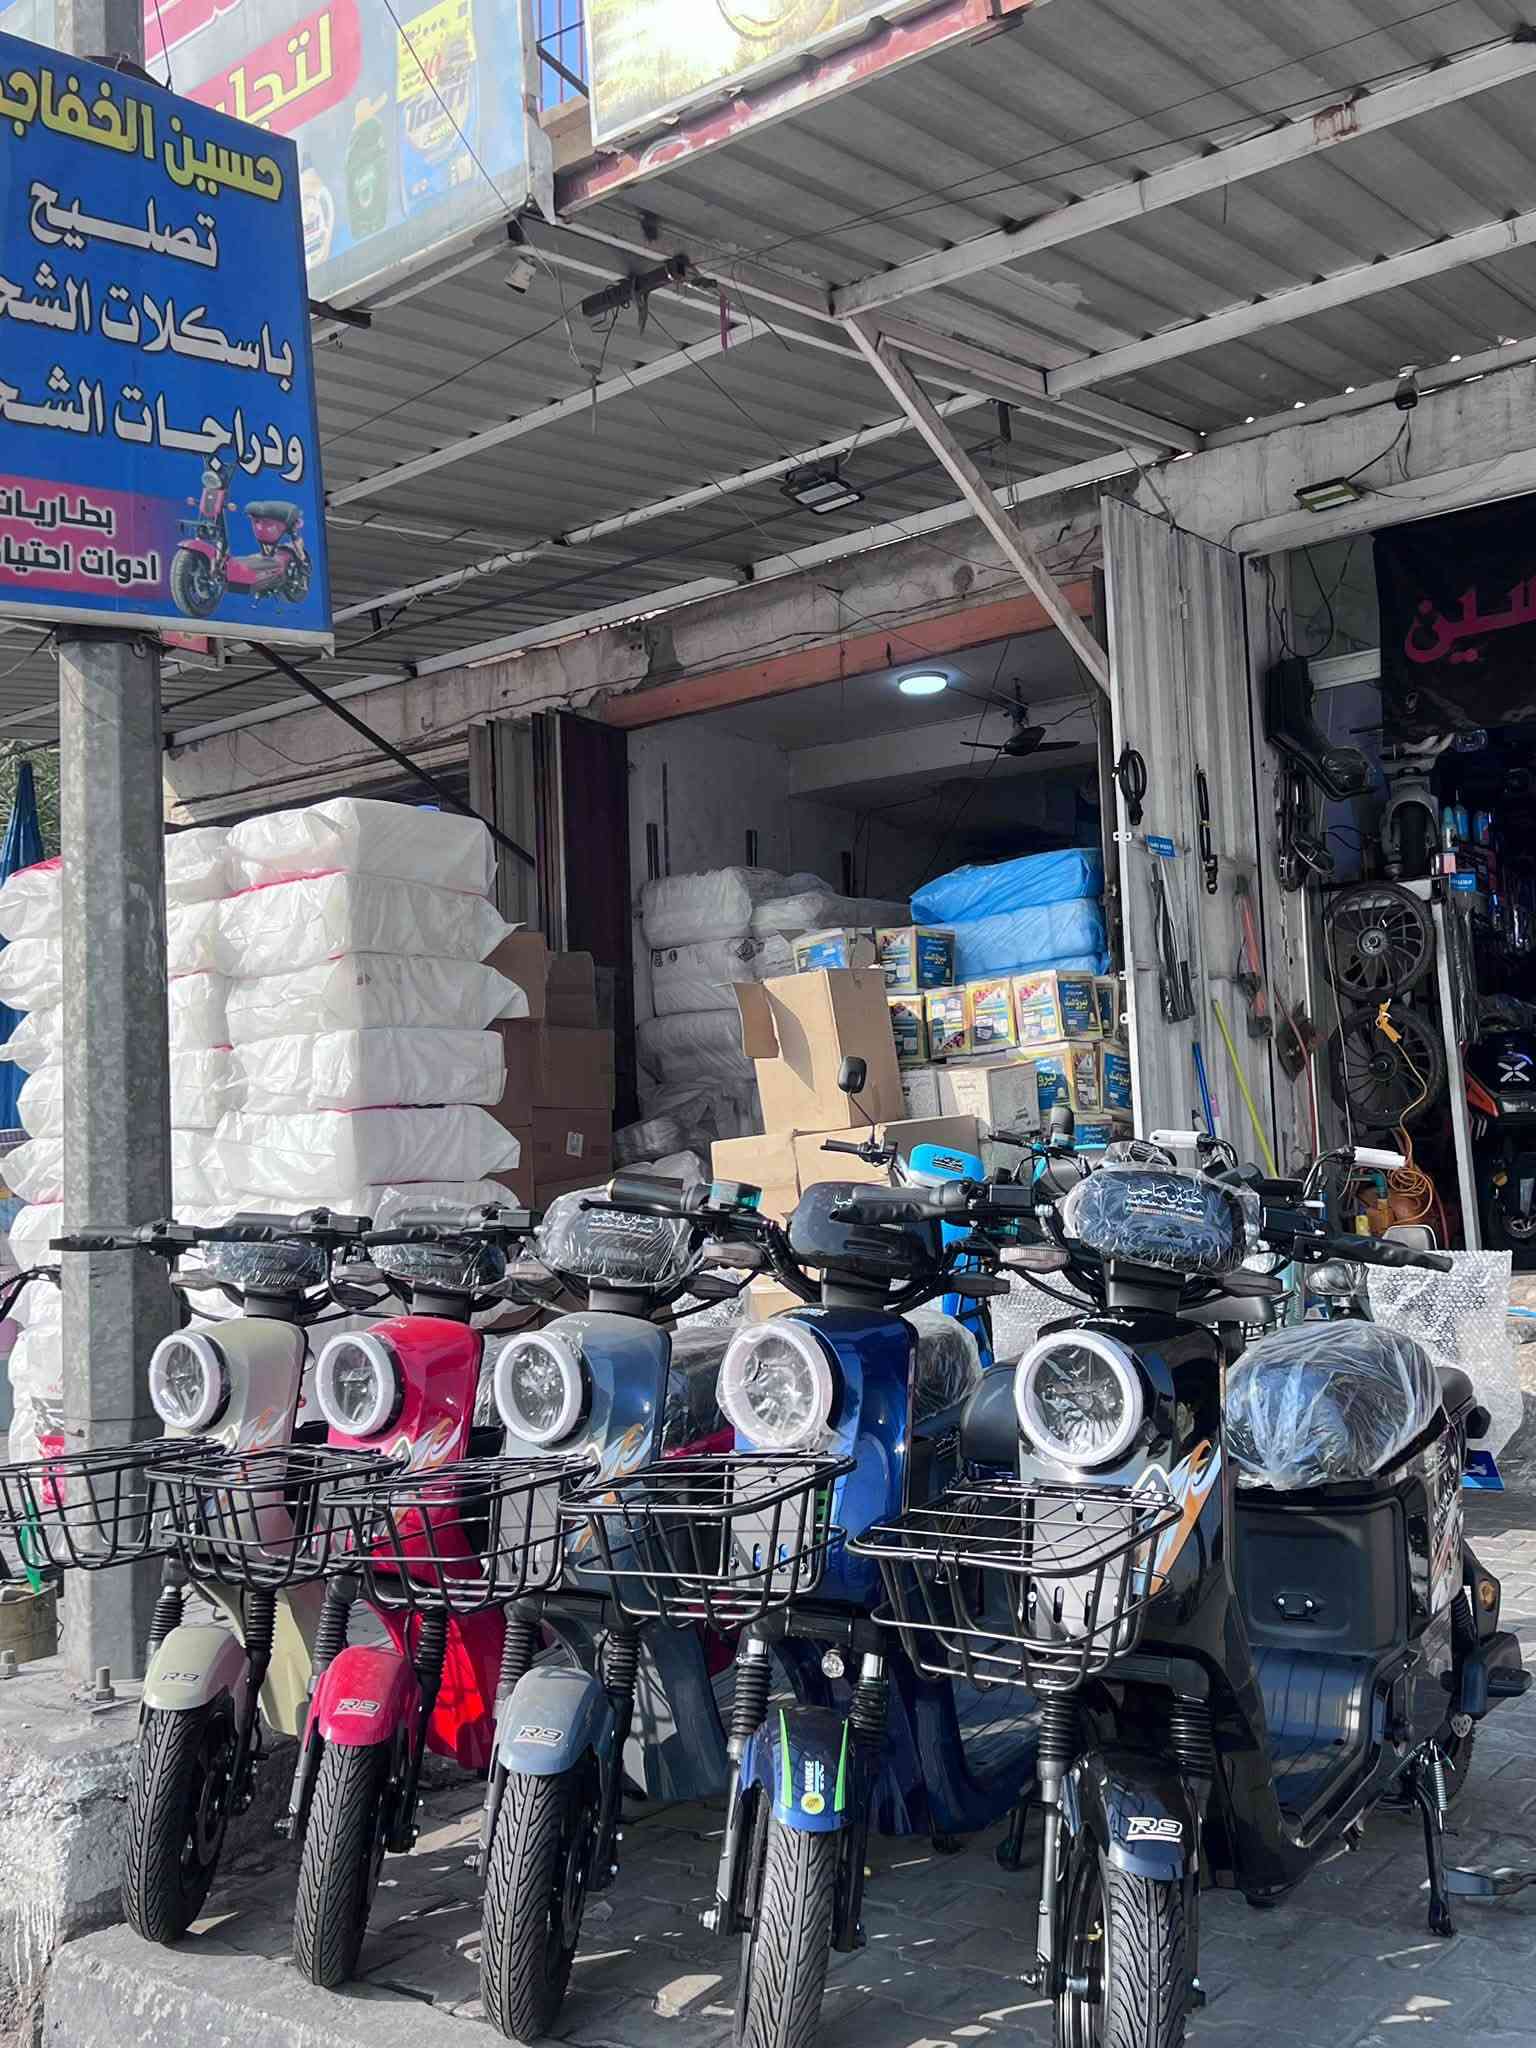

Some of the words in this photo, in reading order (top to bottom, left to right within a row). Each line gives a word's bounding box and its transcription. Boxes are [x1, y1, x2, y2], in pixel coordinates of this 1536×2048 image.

[0, 68, 154, 160] الخفاج
[163, 116, 282, 201] حسين
[31, 181, 218, 268] تصليح
[0, 260, 91, 332] الشح
[101, 285, 293, 392] باسكلات
[0, 365, 104, 434] الشح
[113, 383, 304, 482] ودراجات
[0, 537, 70, 573] احتيا
[80, 549, 157, 585] ادوات
[1127, 1816, 1183, 1836] R9
